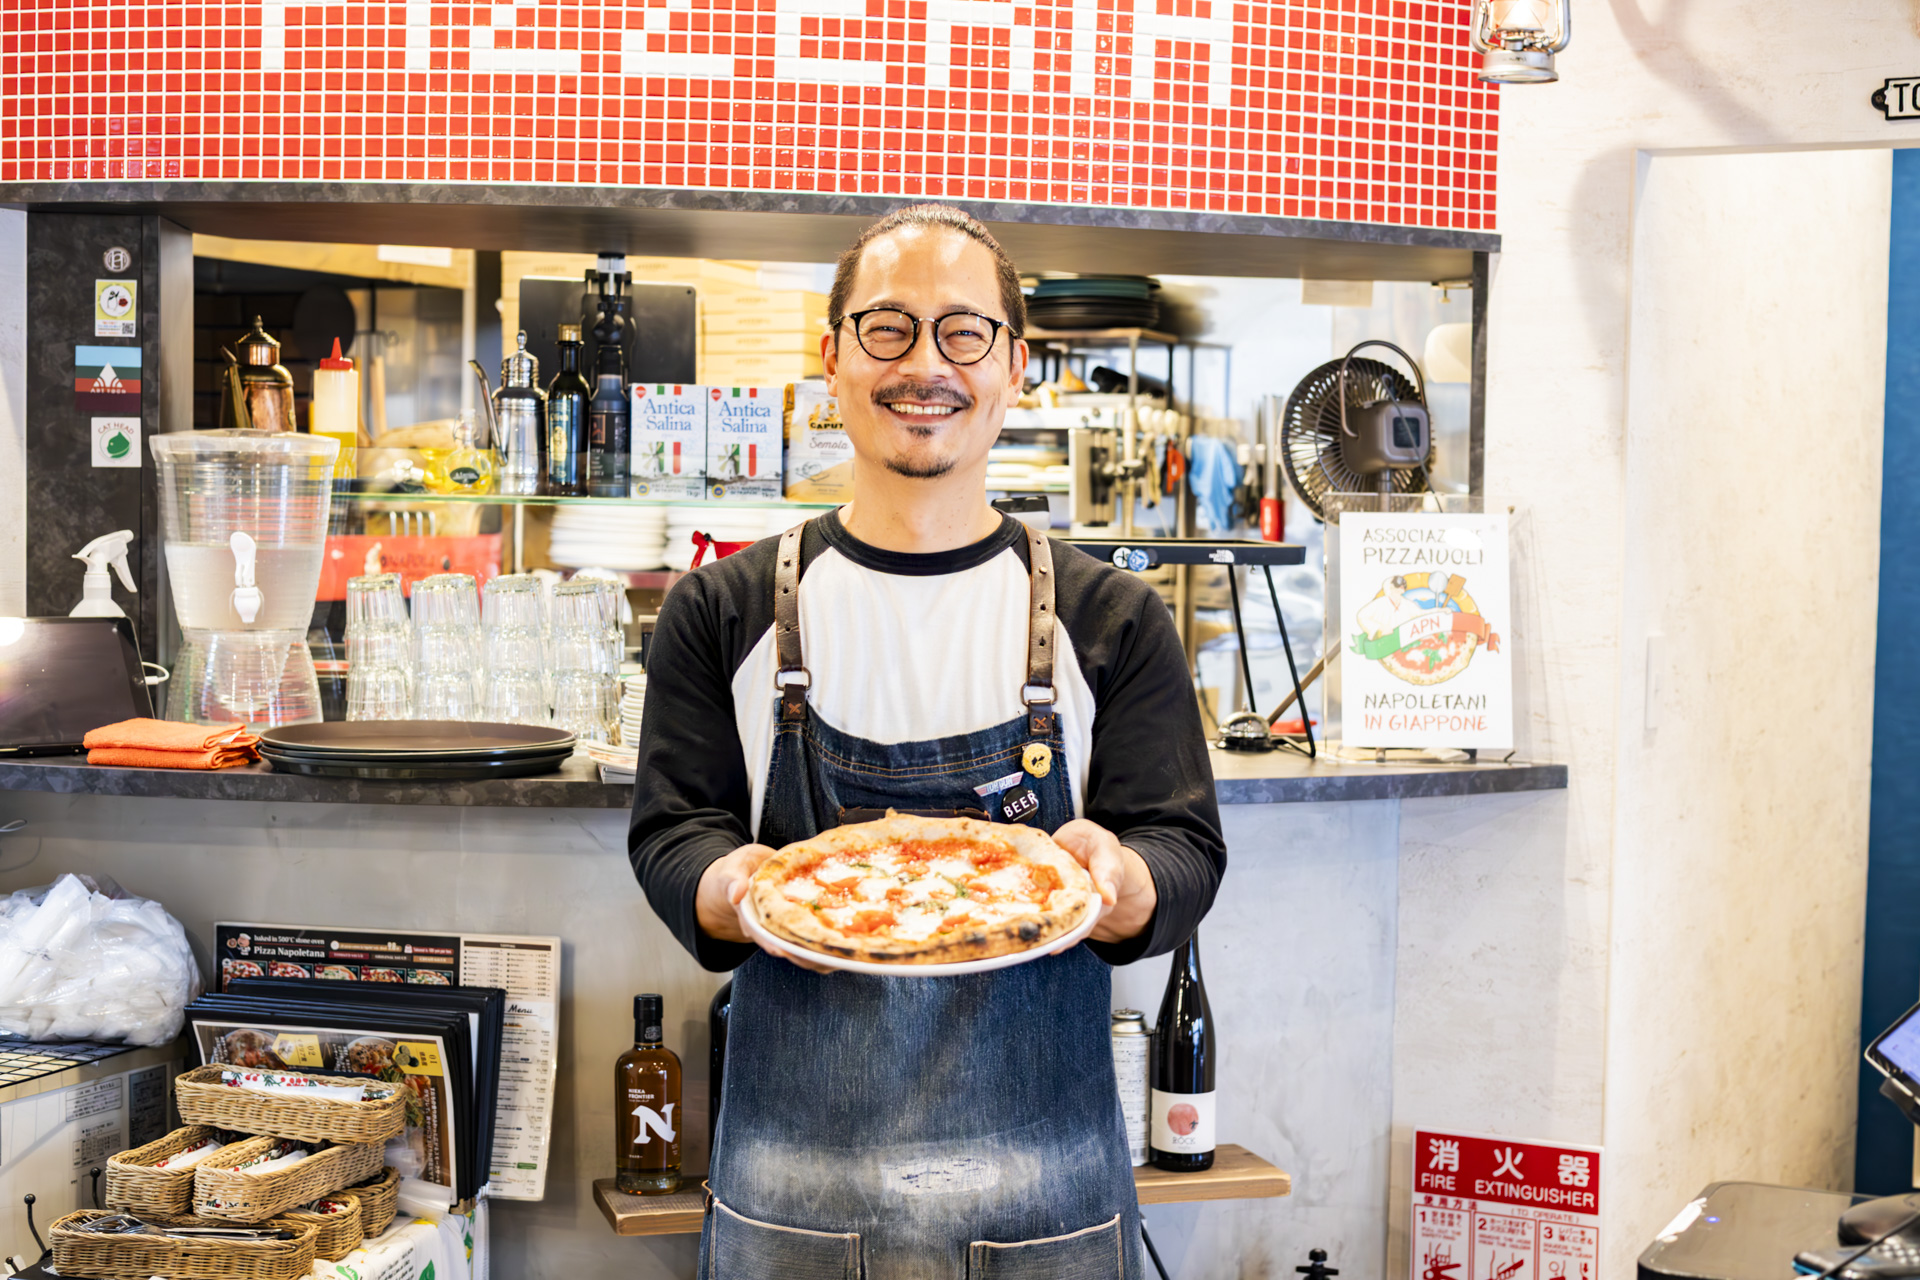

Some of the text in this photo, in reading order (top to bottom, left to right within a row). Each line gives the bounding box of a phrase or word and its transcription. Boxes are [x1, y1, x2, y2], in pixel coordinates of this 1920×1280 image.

[642, 398, 696, 416] Antica
[718, 400, 771, 418] Antica
[98, 422, 135, 435] CAT HEAD
[646, 416, 692, 431] Salina
[721, 418, 768, 433] Salina
[809, 421, 844, 430] CAPUT
[809, 436, 850, 450] Semola
[1363, 528, 1482, 543] ASSOCIAZ
[1410, 616, 1440, 638] APN
[1364, 692, 1486, 710] NAPOLETANI
[1364, 714, 1488, 731] IN GIAPPONE
[1003, 791, 1038, 818] BEER
[254, 946, 325, 958] Pizza Napoletana
[507, 1003, 534, 1015] Menu
[631, 1102, 676, 1144] N
[1428, 1138, 1591, 1187] 消火器
[1421, 1172, 1595, 1209] FIRE EXTINGUISHER
[1419, 1210, 1427, 1223] 1
[1478, 1217, 1487, 1230] 2
[1543, 1226, 1553, 1239] 3
